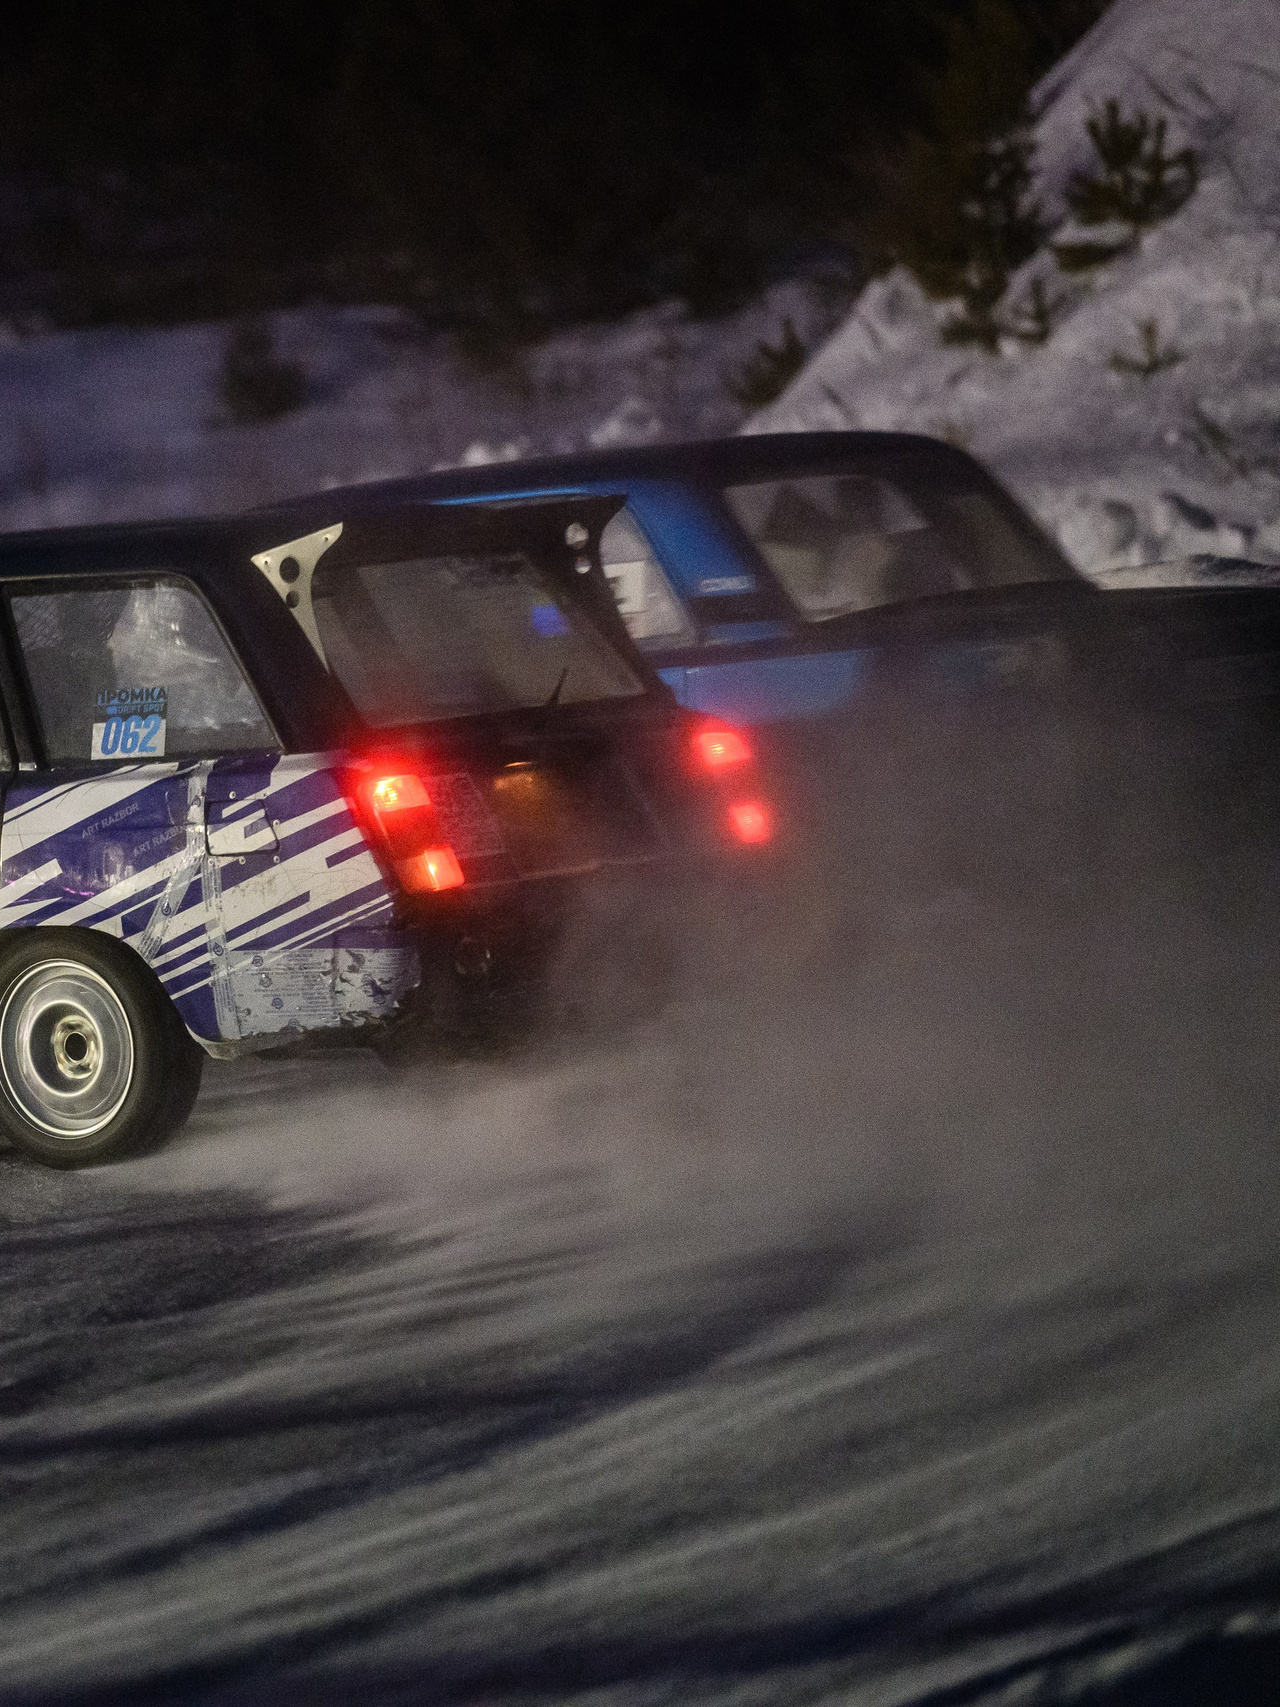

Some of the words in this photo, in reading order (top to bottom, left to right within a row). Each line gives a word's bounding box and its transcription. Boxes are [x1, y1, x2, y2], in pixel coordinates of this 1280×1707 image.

[101, 713, 162, 755] 062
[82, 823, 99, 838] ART
[101, 802, 140, 829] RAZBOR
